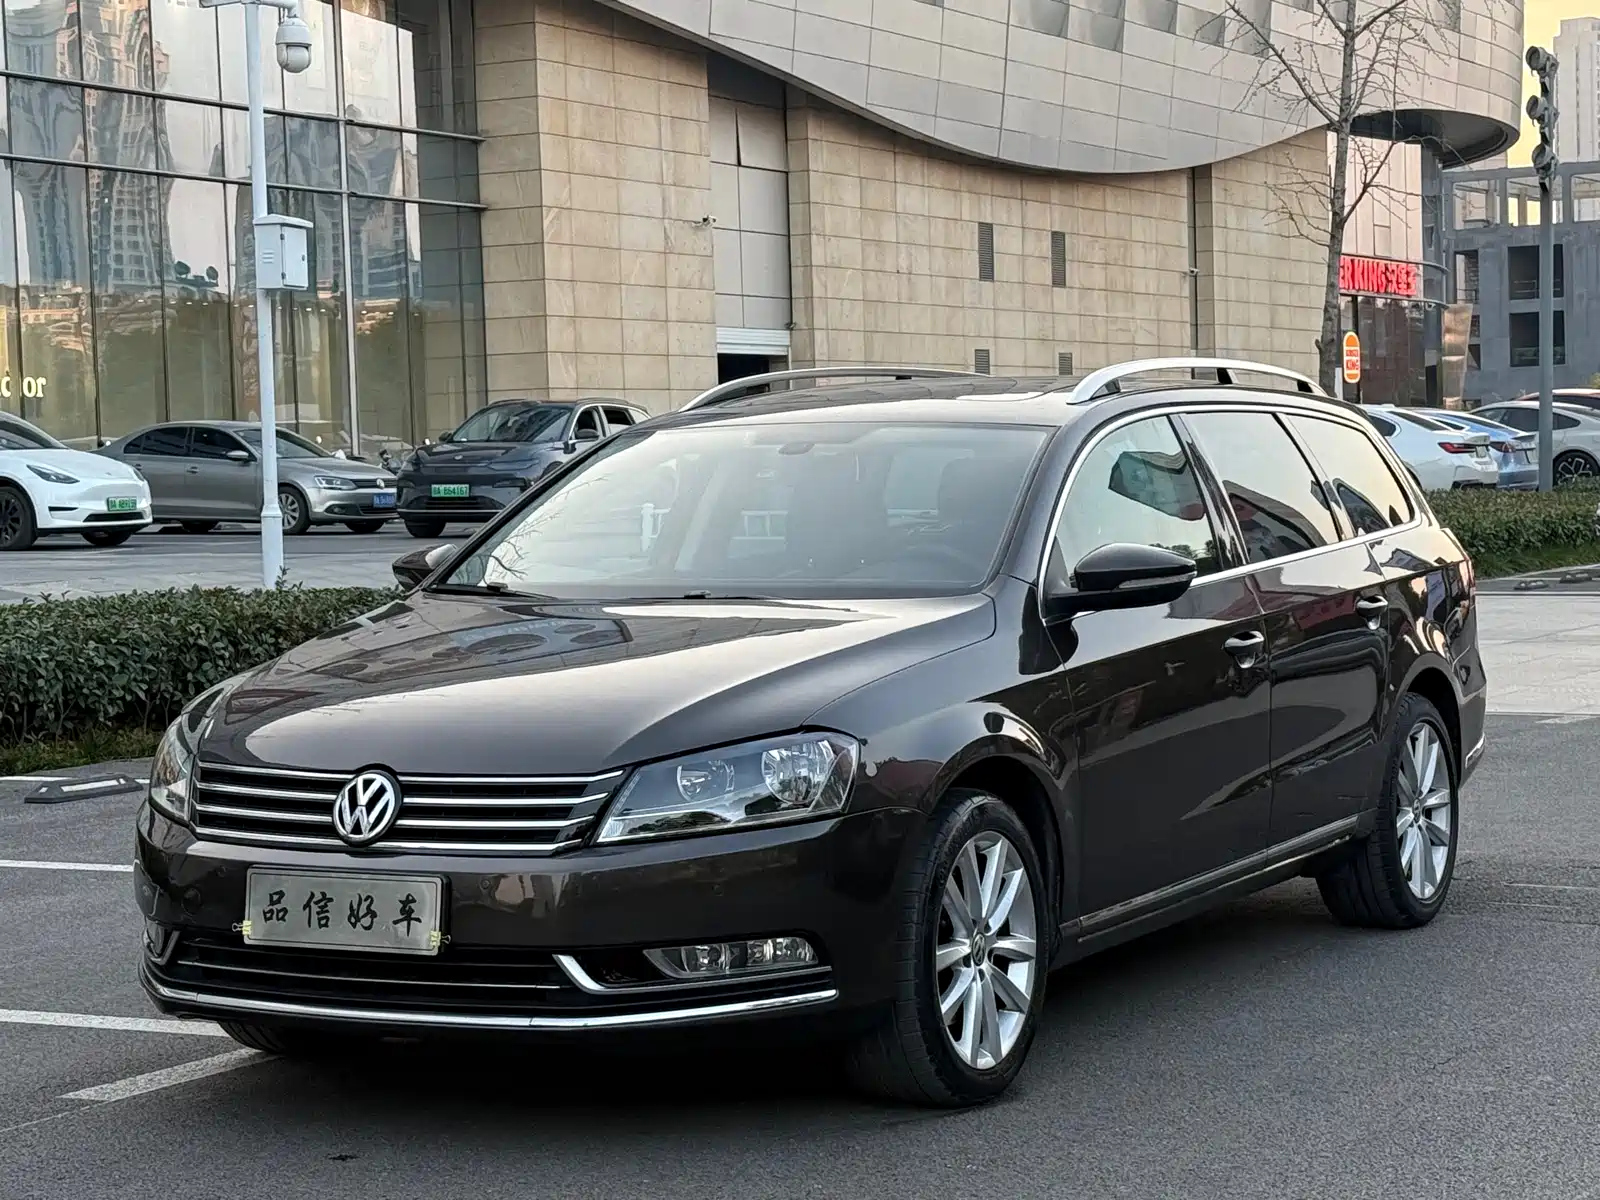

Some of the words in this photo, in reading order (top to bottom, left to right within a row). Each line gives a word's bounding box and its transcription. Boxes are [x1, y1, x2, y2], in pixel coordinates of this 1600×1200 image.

[1354, 258, 1386, 293] KING
[335, 772, 396, 840] VW
[262, 889, 422, 937] 品信好车
